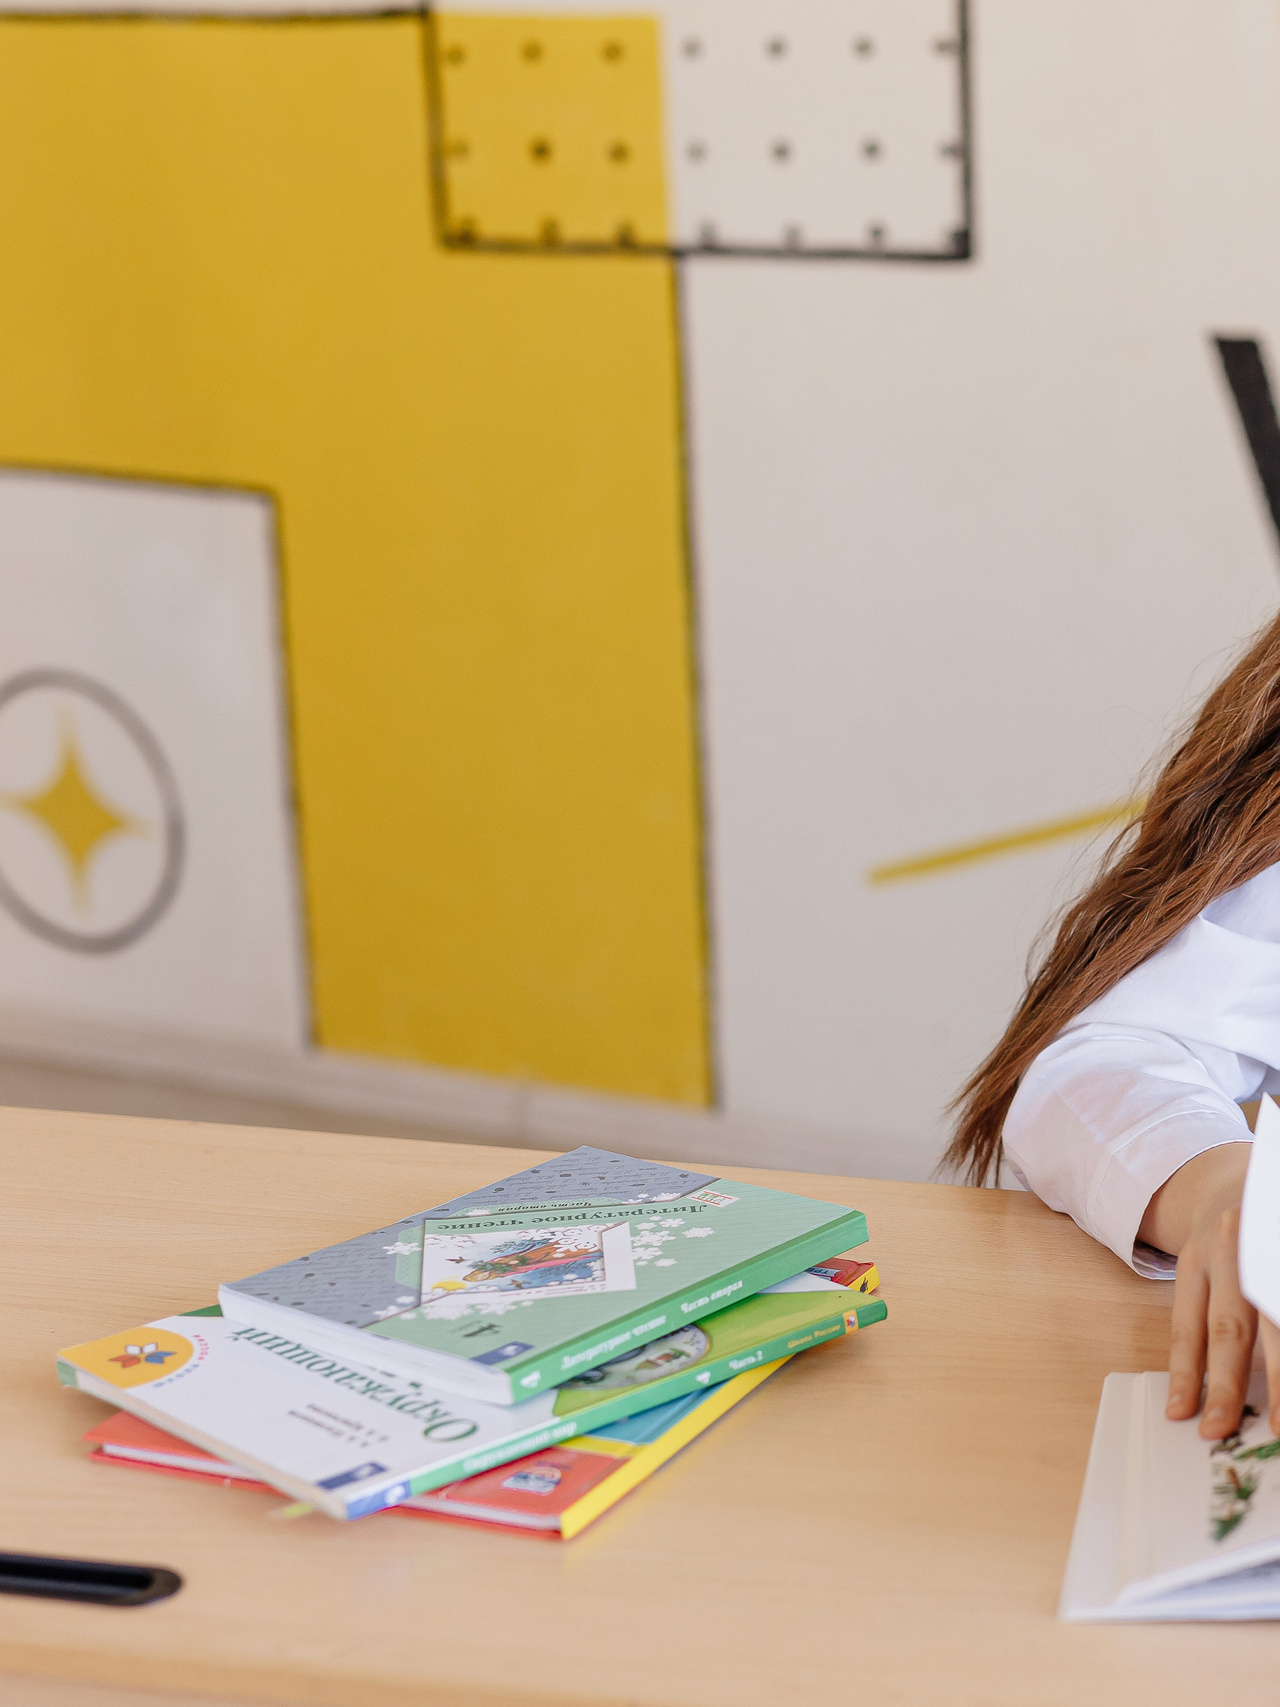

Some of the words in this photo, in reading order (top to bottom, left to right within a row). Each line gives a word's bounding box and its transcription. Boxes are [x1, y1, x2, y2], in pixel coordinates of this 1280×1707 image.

[498, 1203, 547, 1213] вторая
[531, 1204, 708, 1225] Литературное
[437, 1217, 525, 1230] чтение
[681, 1296, 710, 1314] Часть
[226, 1327, 480, 1443] Окружающий
